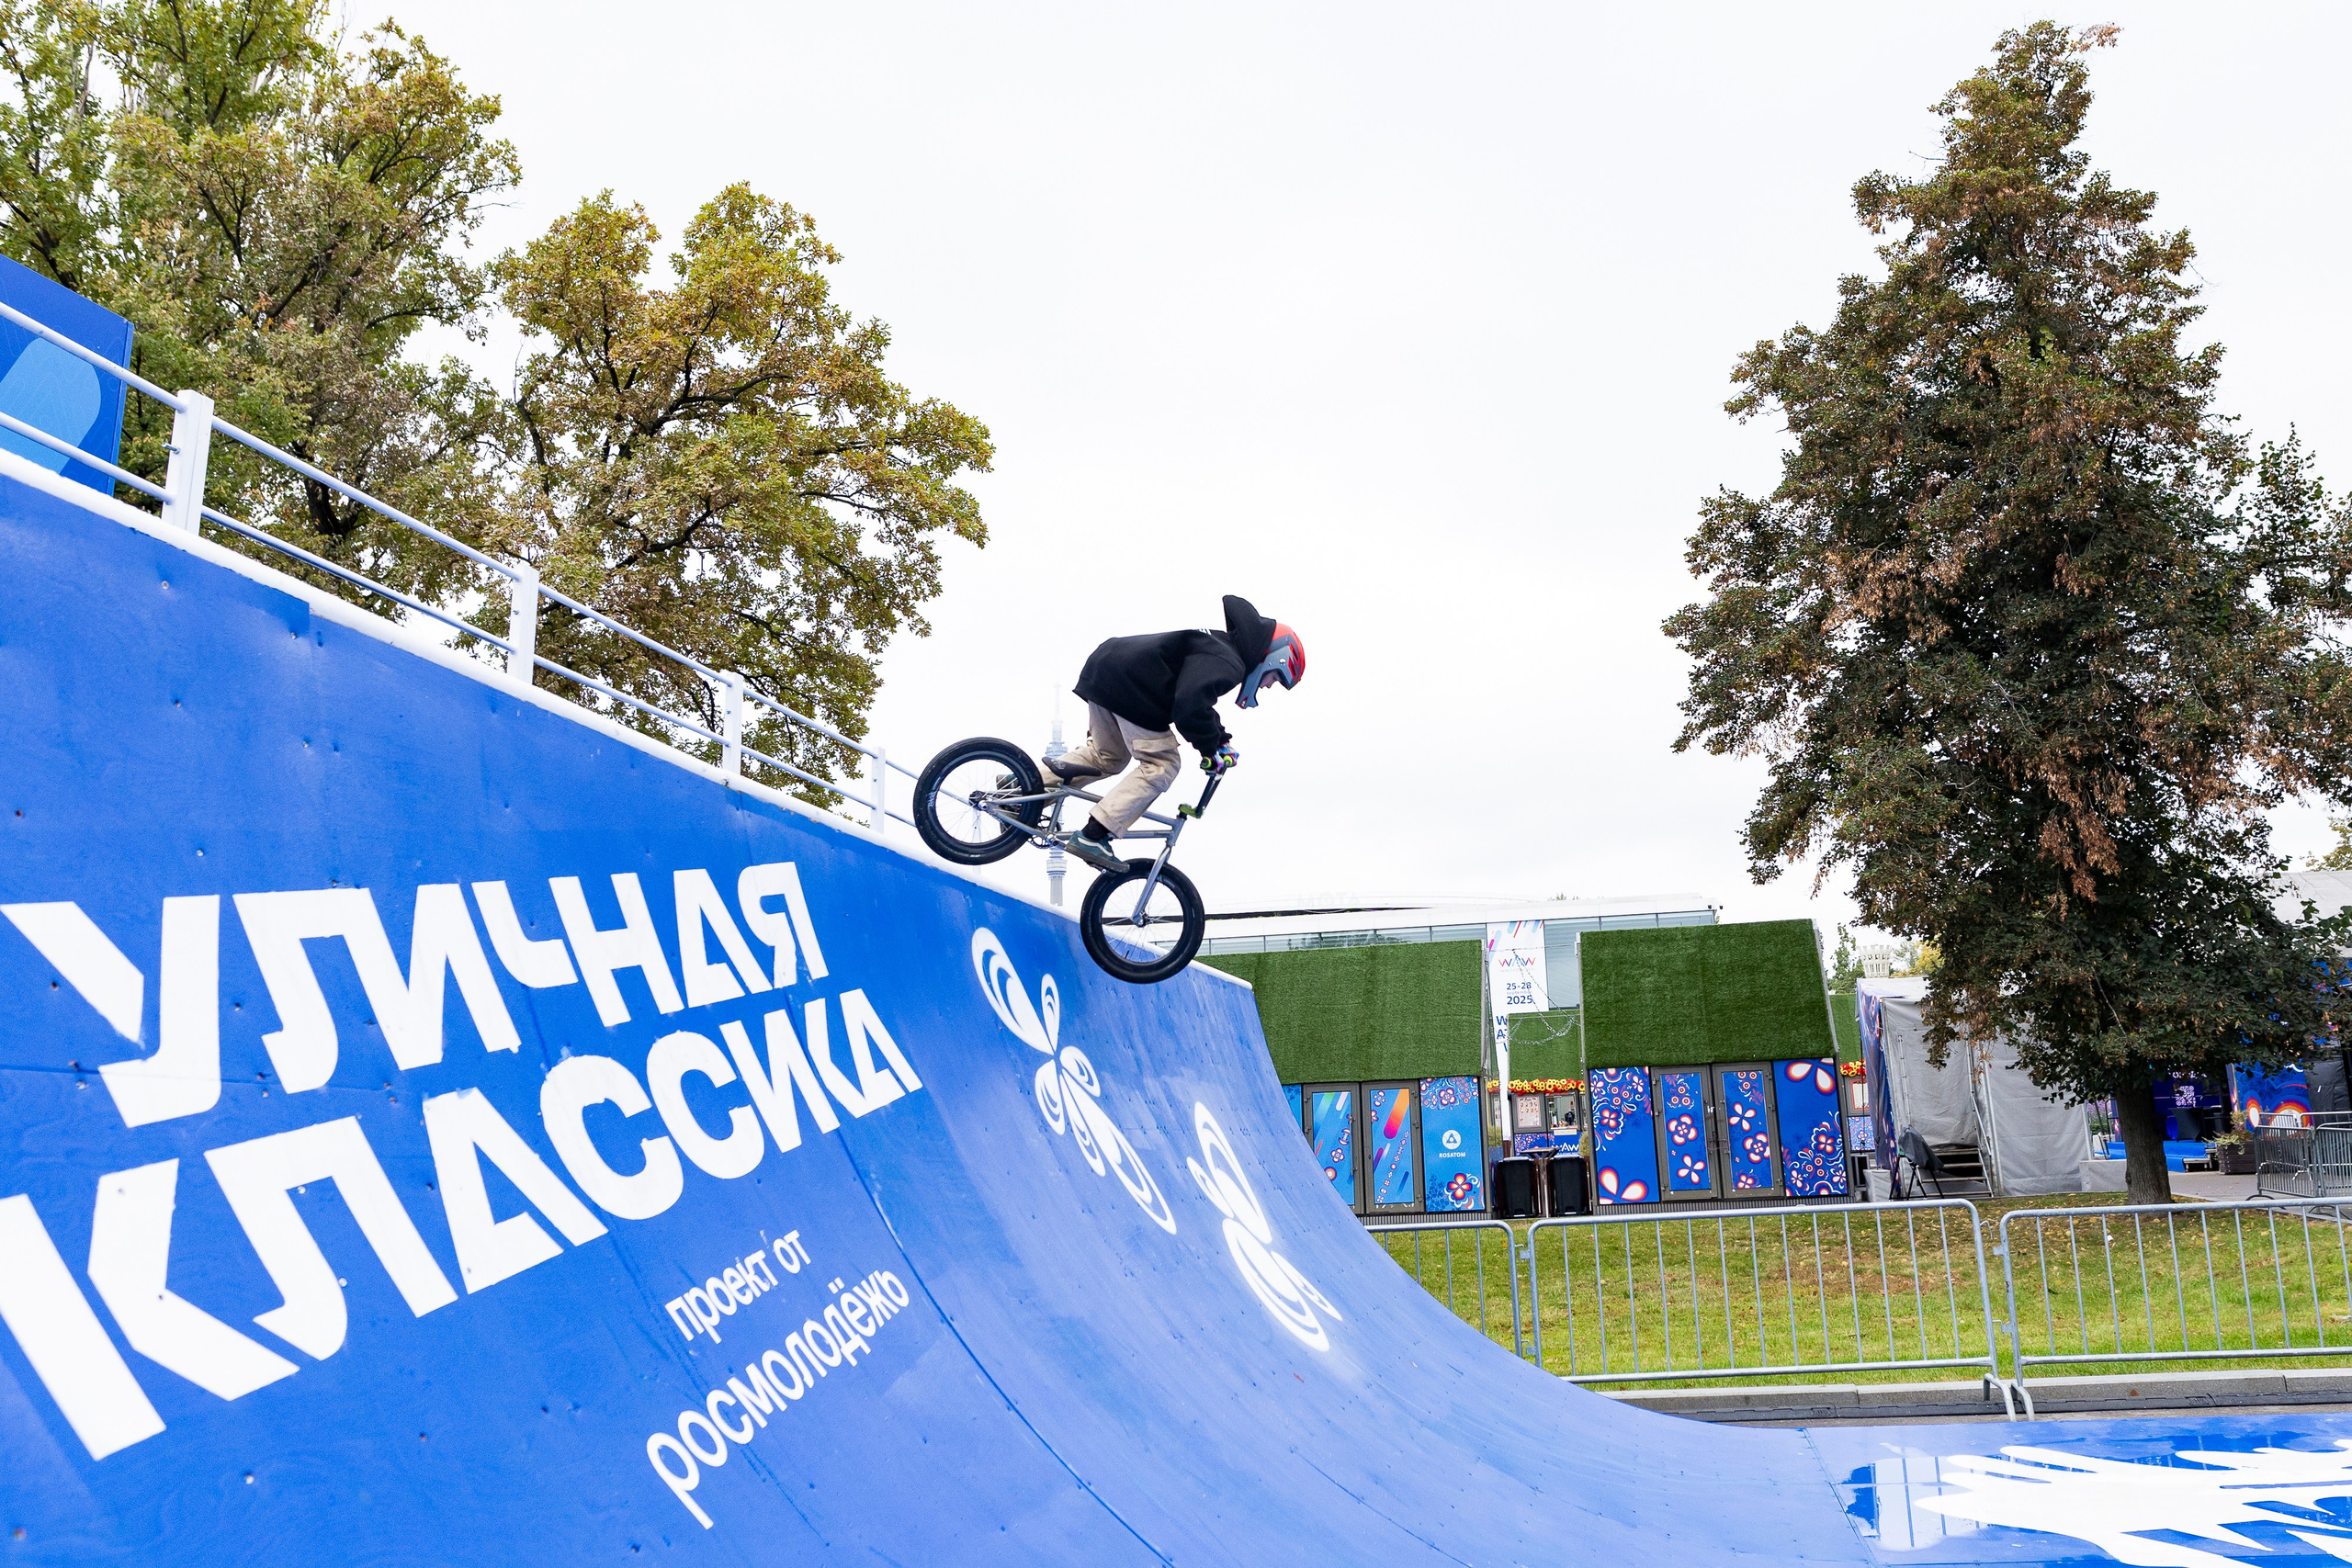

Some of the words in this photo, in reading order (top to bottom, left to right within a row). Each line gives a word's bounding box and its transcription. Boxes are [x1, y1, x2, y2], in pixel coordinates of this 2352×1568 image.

[0, 862, 829, 1128] УЛИЧНАЯ
[1498, 954, 1535, 968] WAW
[1507, 995, 1532, 1005] 2025
[0, 988, 922, 1461] КЛАССИКА
[664, 1249, 779, 1345] проект
[773, 1229, 811, 1274] от
[646, 1269, 910, 1530] росмолодёжь
